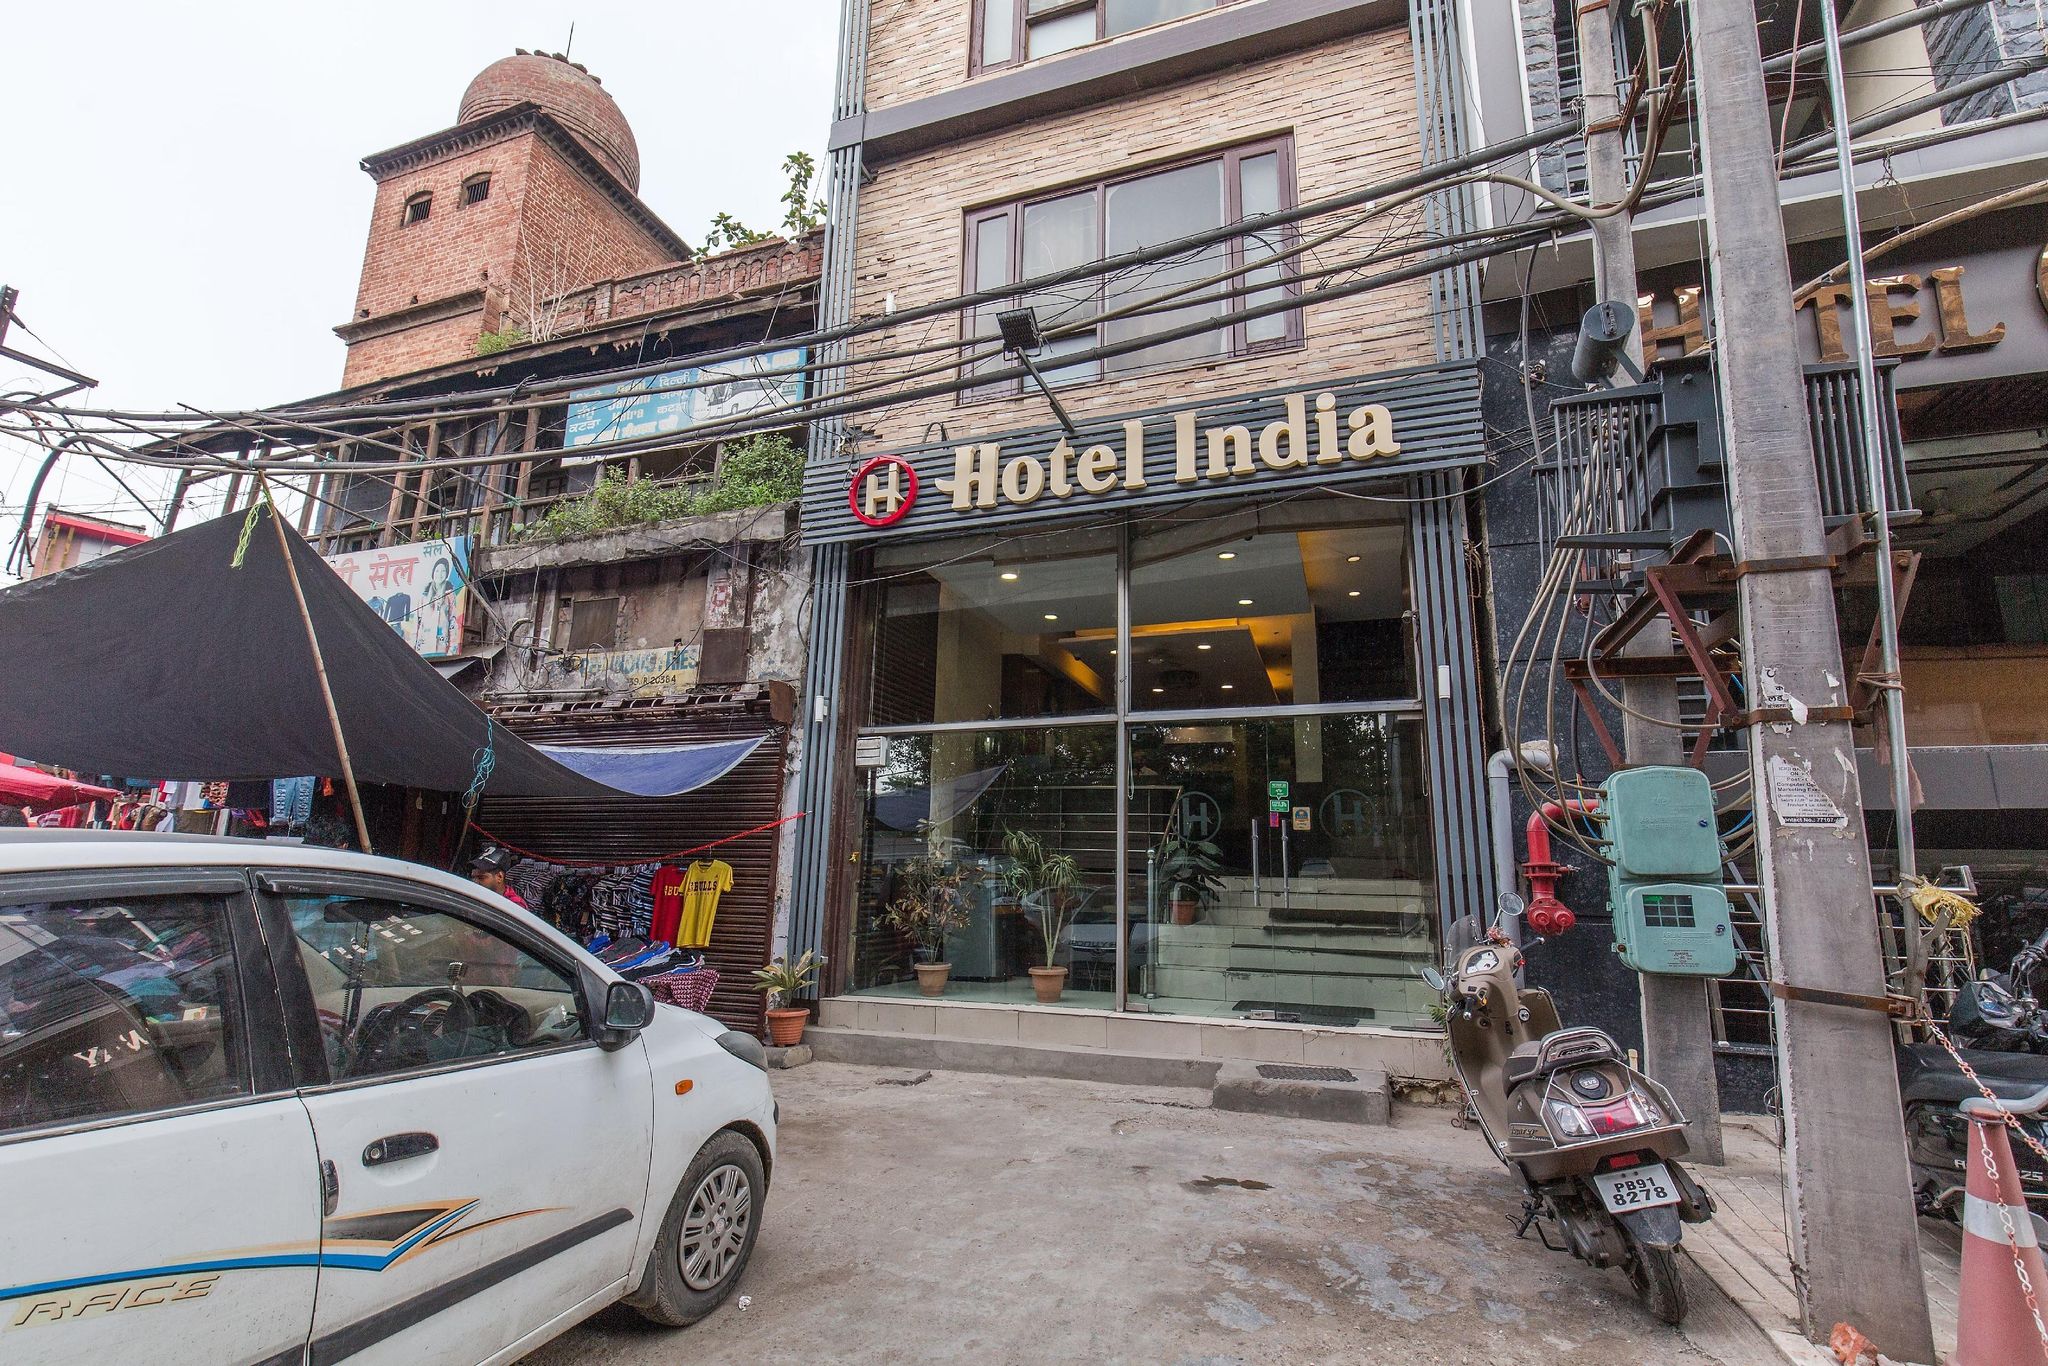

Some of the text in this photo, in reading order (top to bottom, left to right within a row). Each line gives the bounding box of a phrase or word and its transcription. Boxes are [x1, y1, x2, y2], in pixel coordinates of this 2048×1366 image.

[1637, 265, 2006, 365] HTEL
[934, 392, 1402, 512] Hotel India
[368, 553, 420, 590] सेल
[1583, 1078, 1597, 1086] TVS
[1612, 1186, 1668, 1206] 8278
[1613, 1176, 1656, 1193] PB91
[14, 1275, 221, 1327] RACE
